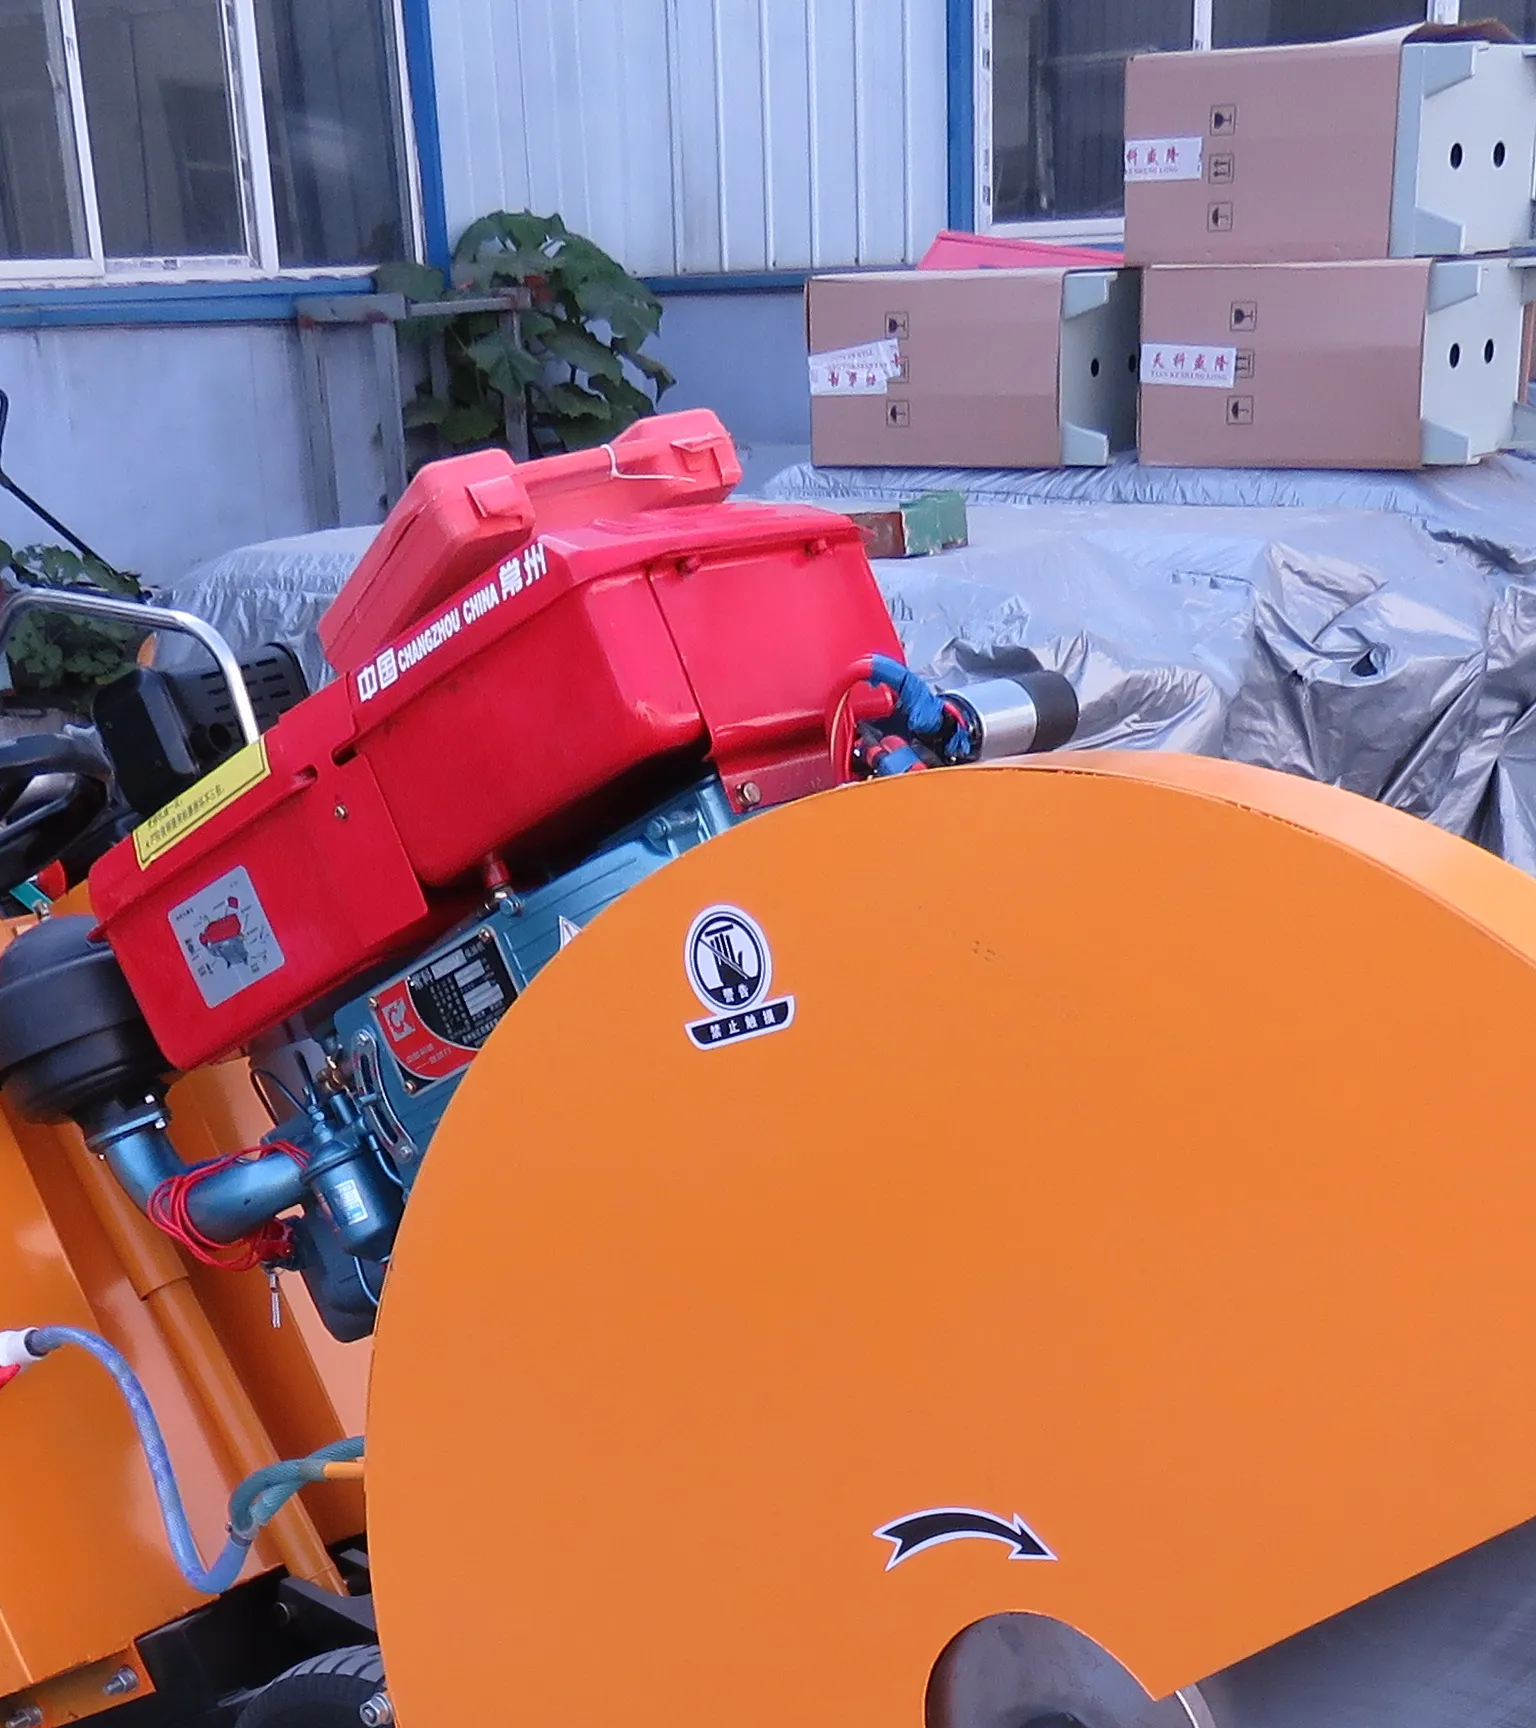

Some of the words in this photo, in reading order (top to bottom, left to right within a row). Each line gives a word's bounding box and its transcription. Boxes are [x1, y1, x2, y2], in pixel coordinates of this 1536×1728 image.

[1152, 351, 1228, 372] 天科盛隆
[357, 647, 399, 702] 中国
[397, 607, 462, 672] CHANGZHOU
[463, 583, 500, 625] CHINA
[499, 543, 548, 601] 常州
[722, 984, 749, 1003] 警告
[710, 1008, 776, 1040] 禁止触摸
